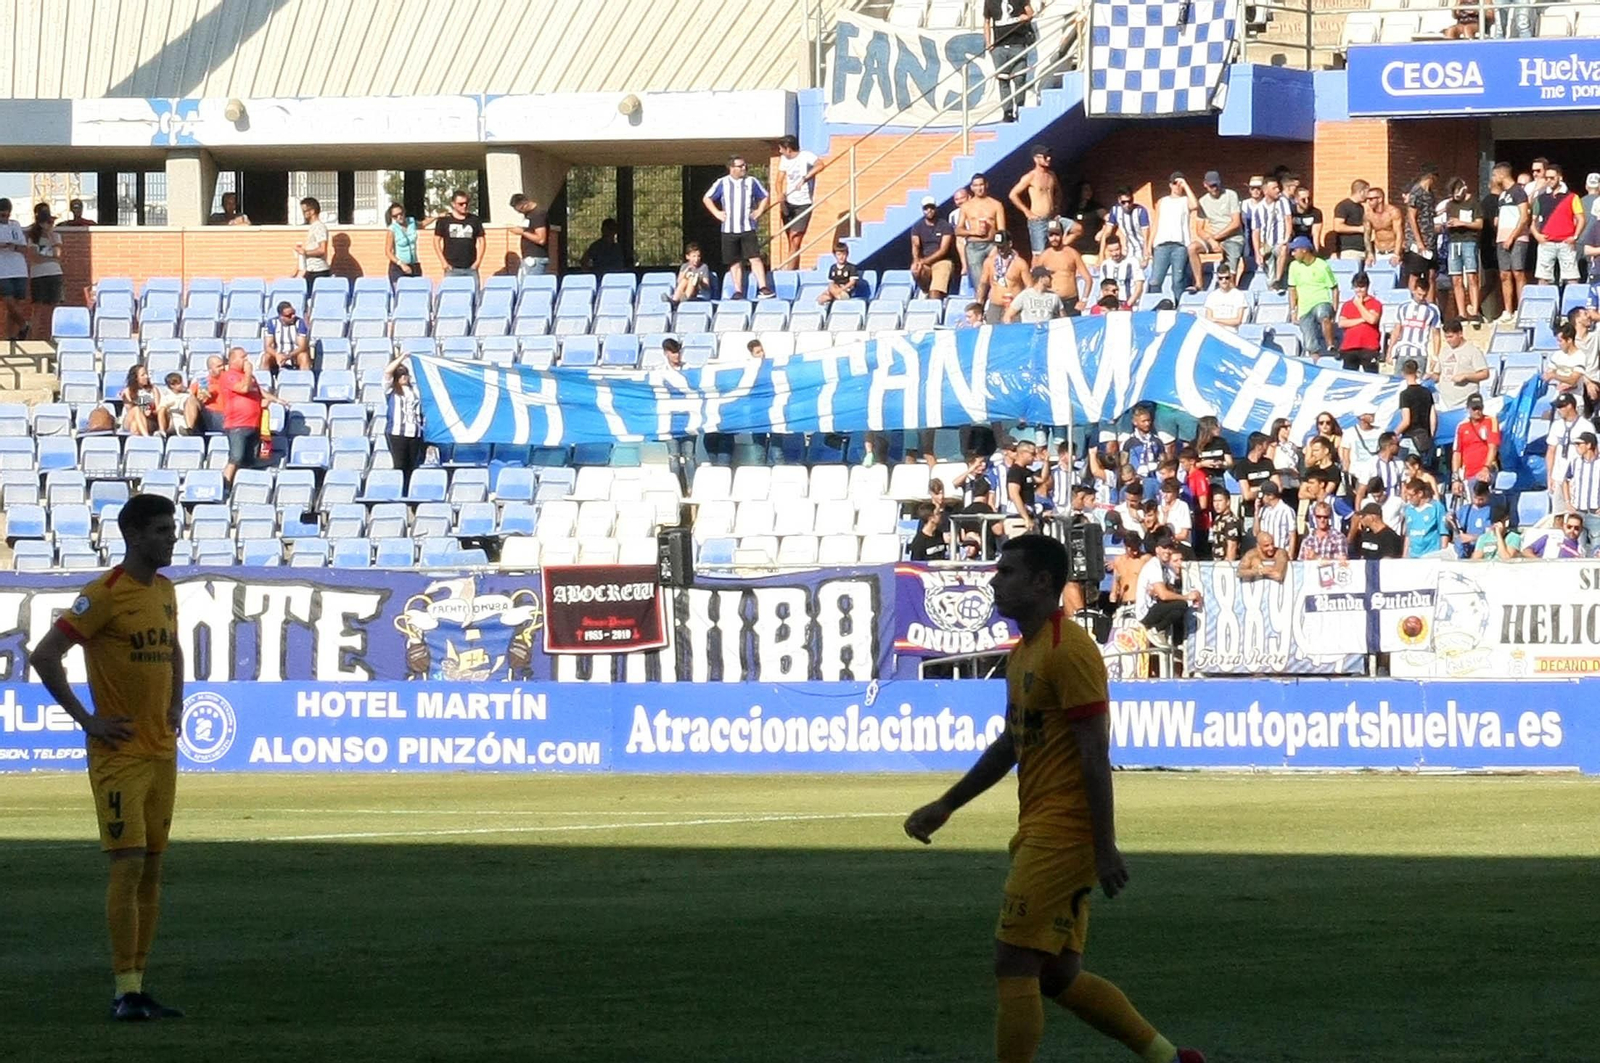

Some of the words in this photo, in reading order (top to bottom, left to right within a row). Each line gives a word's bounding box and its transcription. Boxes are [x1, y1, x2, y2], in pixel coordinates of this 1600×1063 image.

[1381, 61, 1484, 96] CEOSA
[1541, 86, 1565, 98] me
[1315, 594, 1365, 611] Banda
[1371, 591, 1431, 611] Suicida
[129, 628, 171, 650] UCA
[907, 621, 1010, 653] ONUBAS
[1540, 660, 1588, 672] DECANO
[296, 691, 406, 718] HOTEL
[416, 688, 547, 720] MARTÍN
[626, 703, 1005, 754] Atraccioneslacinta.c
[249, 736, 388, 764] ALONSO
[398, 731, 601, 765] PINZÓN.COM
[108, 790, 121, 819] 4
